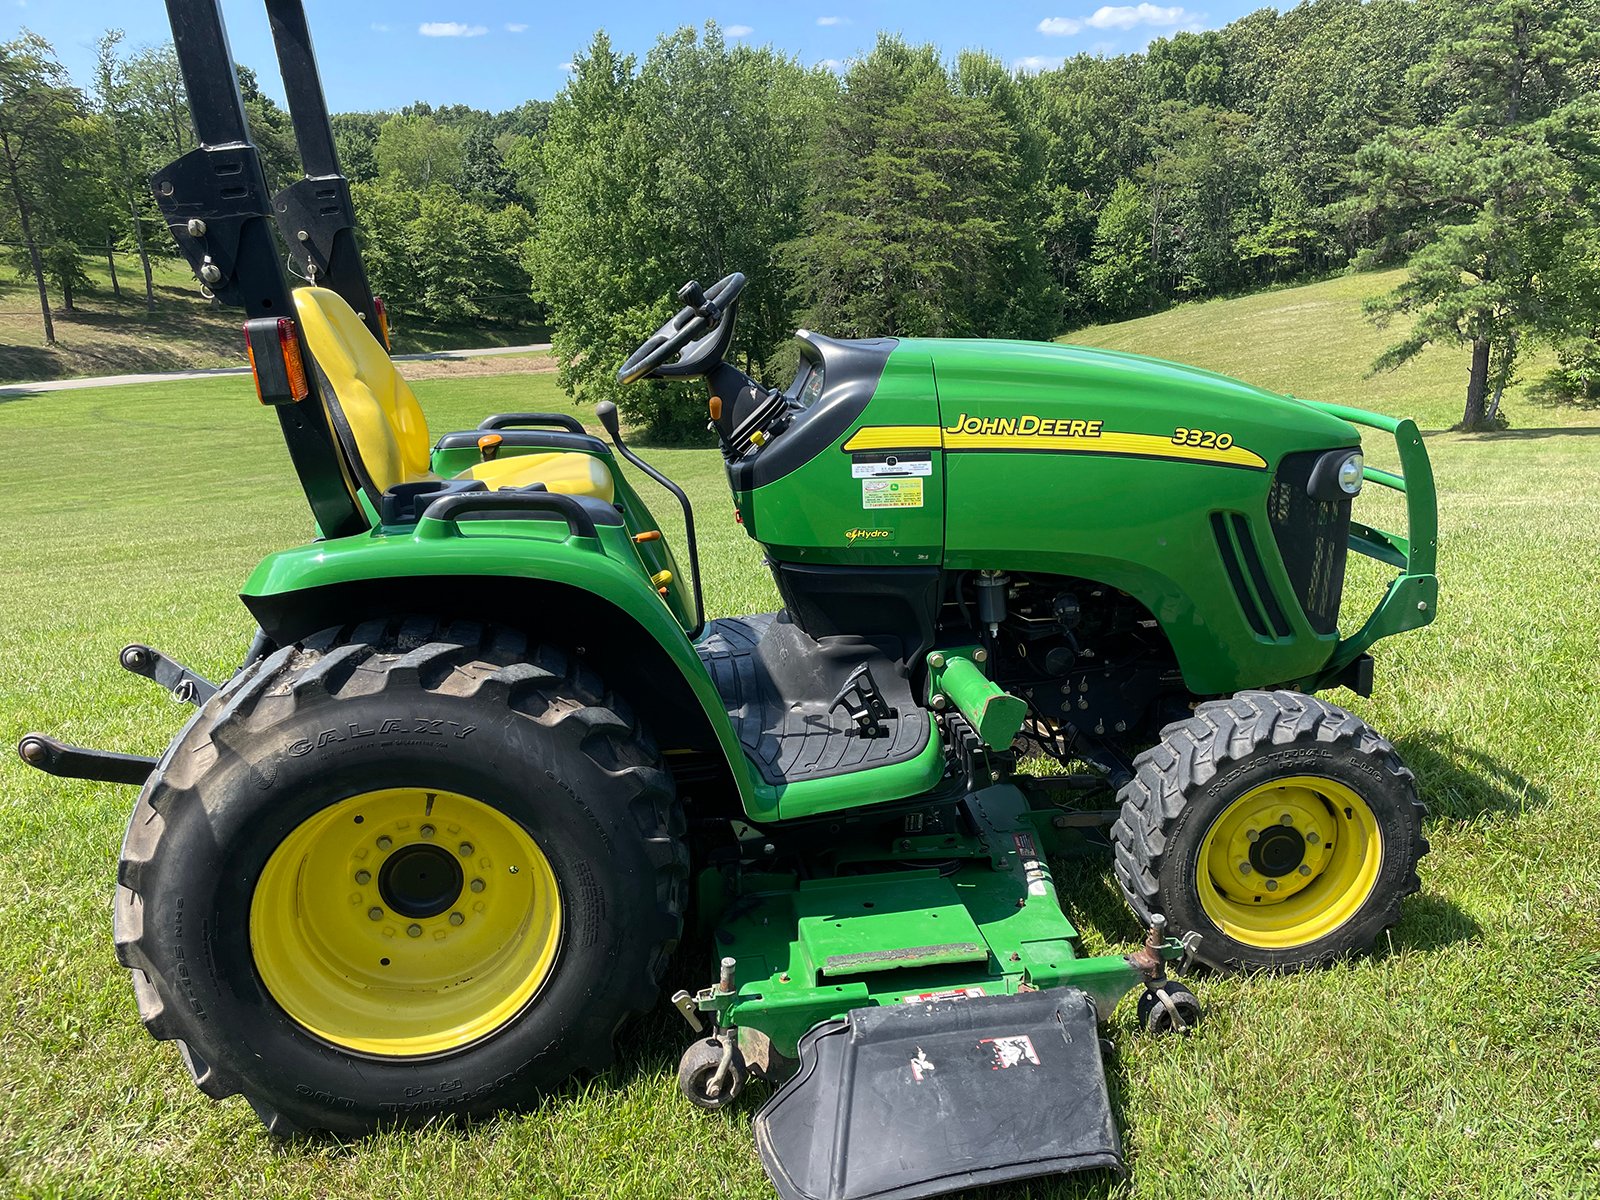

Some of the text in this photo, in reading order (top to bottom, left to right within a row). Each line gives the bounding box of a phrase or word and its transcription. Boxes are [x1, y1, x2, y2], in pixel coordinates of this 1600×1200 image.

[1171, 427, 1234, 450] 3320
[287, 717, 478, 758] GALAXY
[1207, 749, 1383, 798] INDUSTRIAL LUG
